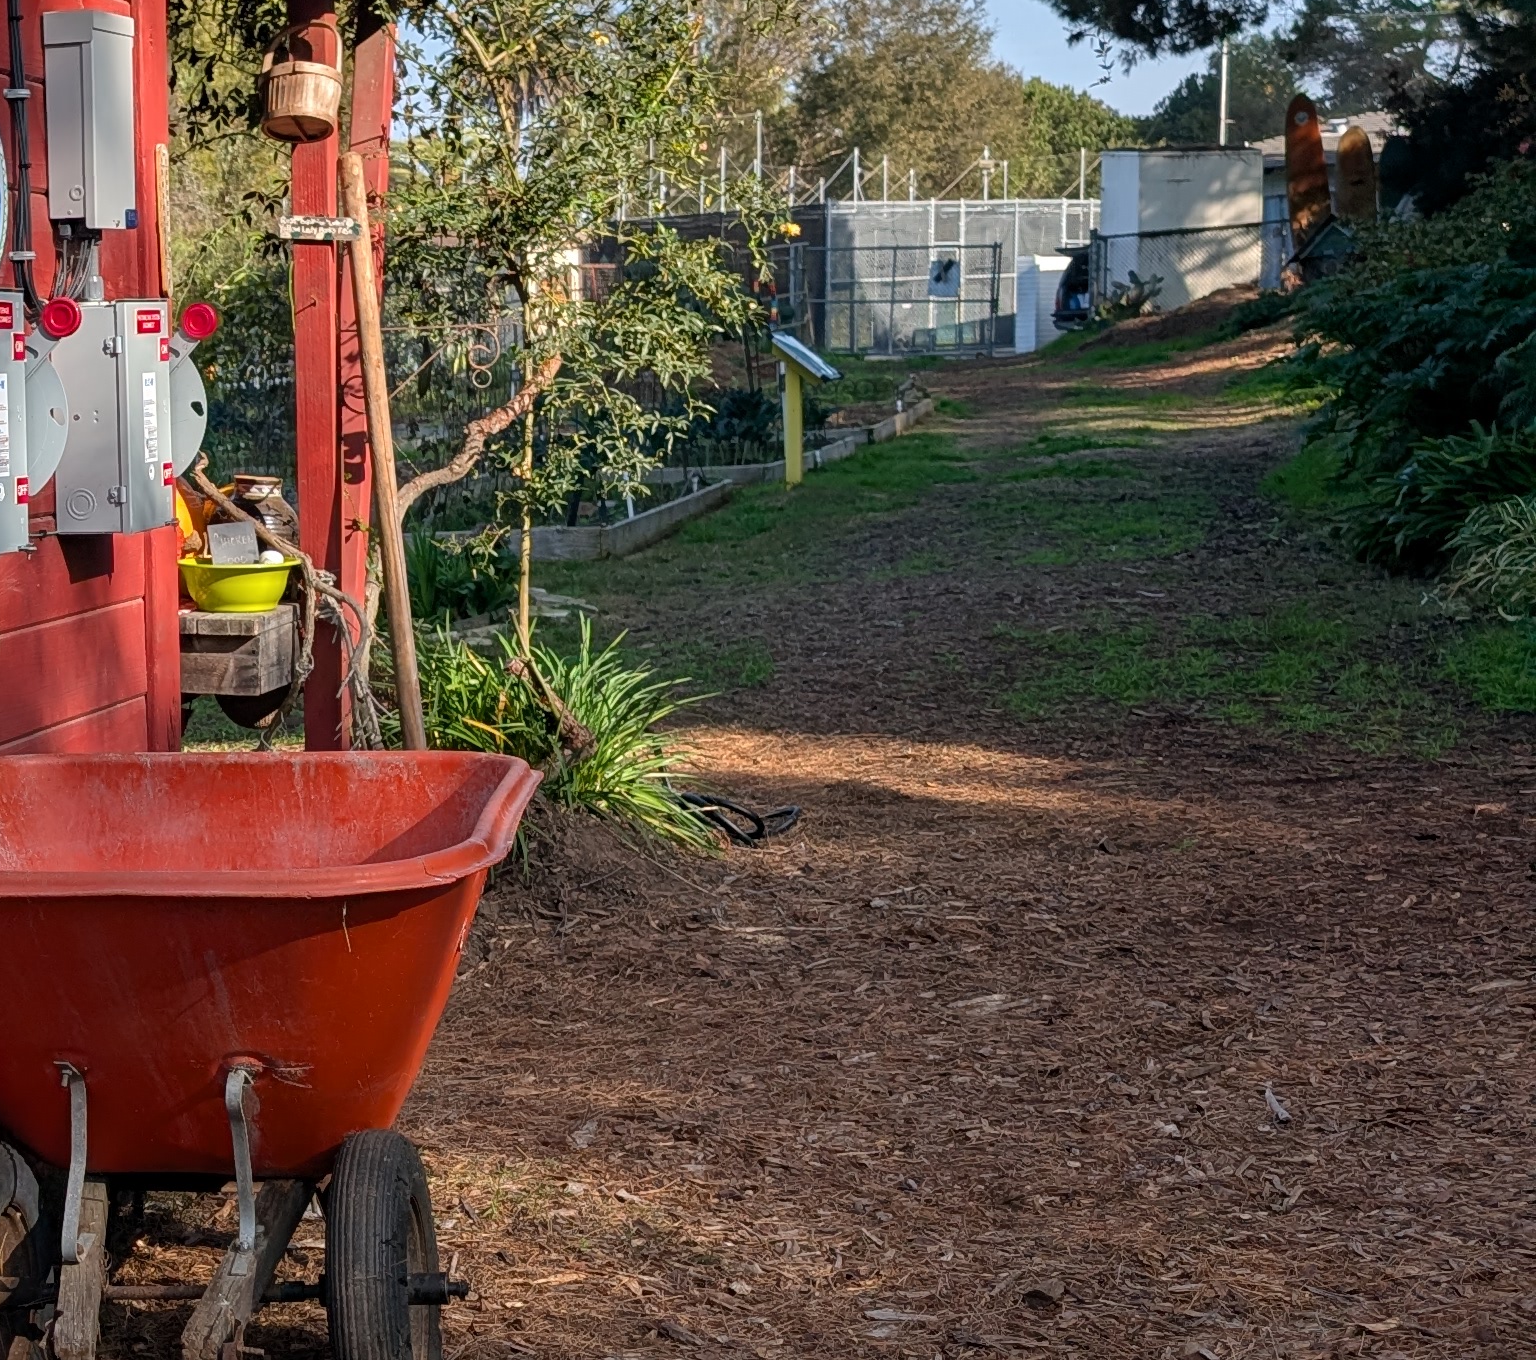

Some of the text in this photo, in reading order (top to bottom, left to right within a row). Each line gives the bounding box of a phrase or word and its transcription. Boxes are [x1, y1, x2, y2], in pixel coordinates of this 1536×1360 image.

[14, 340, 23, 352] ON
[163, 467, 173, 479] OFF
[17, 484, 29, 496] OFF
